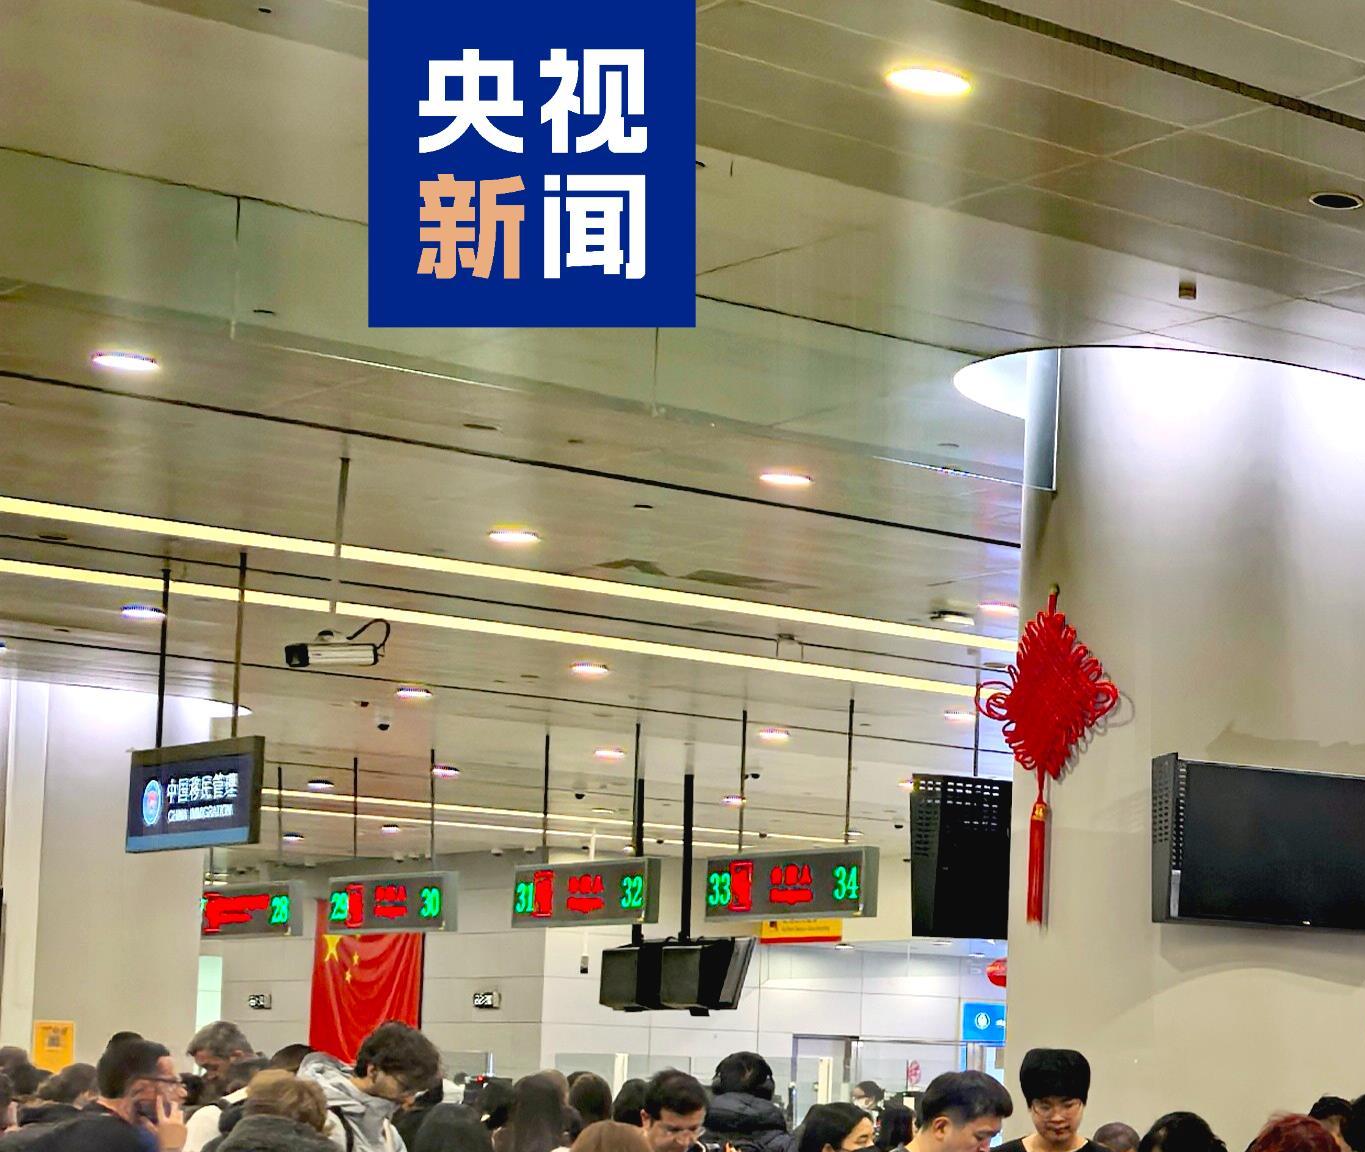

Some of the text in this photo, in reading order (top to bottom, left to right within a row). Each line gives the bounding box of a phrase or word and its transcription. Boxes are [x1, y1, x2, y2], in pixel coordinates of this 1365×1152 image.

[514, 882, 535, 914] 31
[620, 875, 645, 909] 32
[708, 873, 732, 906] 33
[832, 865, 860, 900] 34
[419, 886, 442, 918] 30
